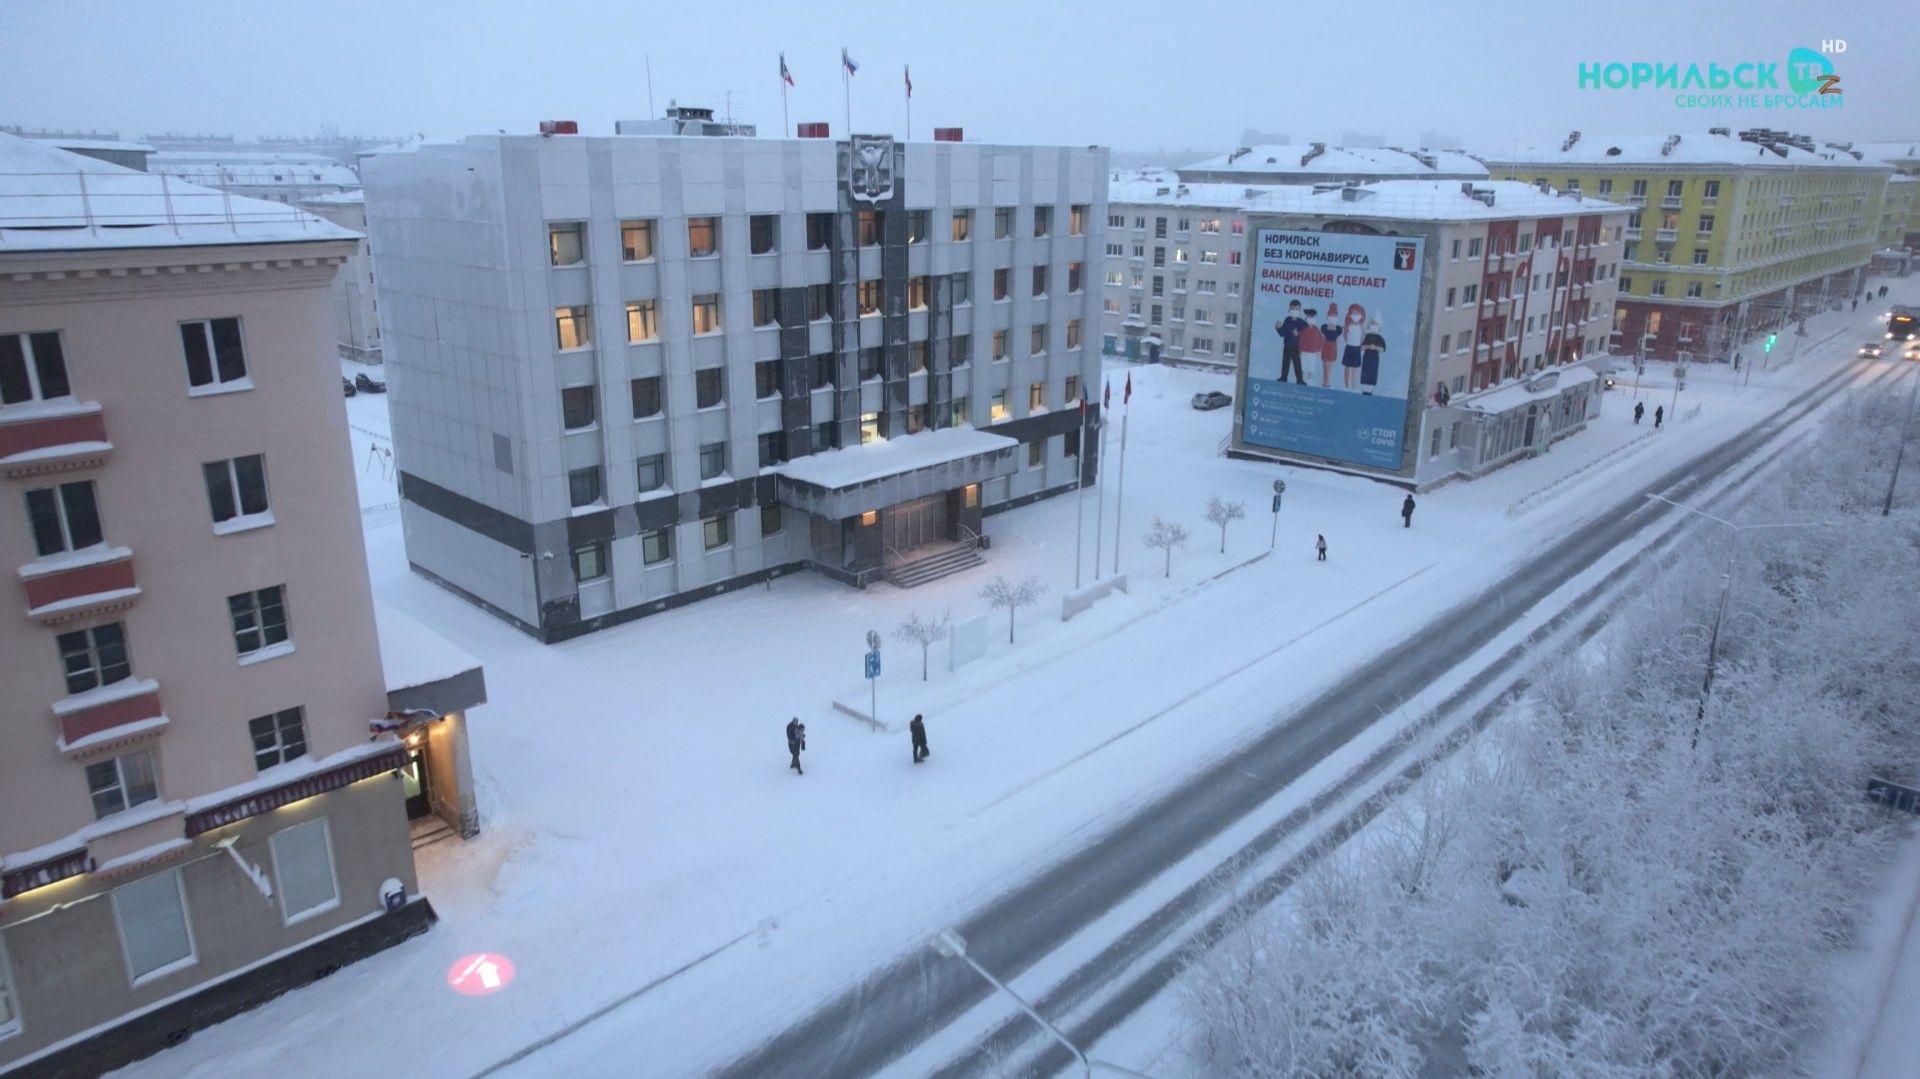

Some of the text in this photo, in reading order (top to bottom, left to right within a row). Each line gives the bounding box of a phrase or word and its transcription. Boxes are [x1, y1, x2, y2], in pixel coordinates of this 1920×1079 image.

[1265, 234, 1320, 246] НОРИЛЬСК
[1264, 248, 1369, 265] БЕЗ КОРОНАВИРУСА
[1262, 269, 1387, 288] ВАКЦИНАЦИЯ СДЕЛАЕТ
[1261, 283, 1334, 298] НАС СИЛЬНЕЕ!
[1372, 428, 1396, 438] СТОП
[1371, 437, 1396, 447] COVID
